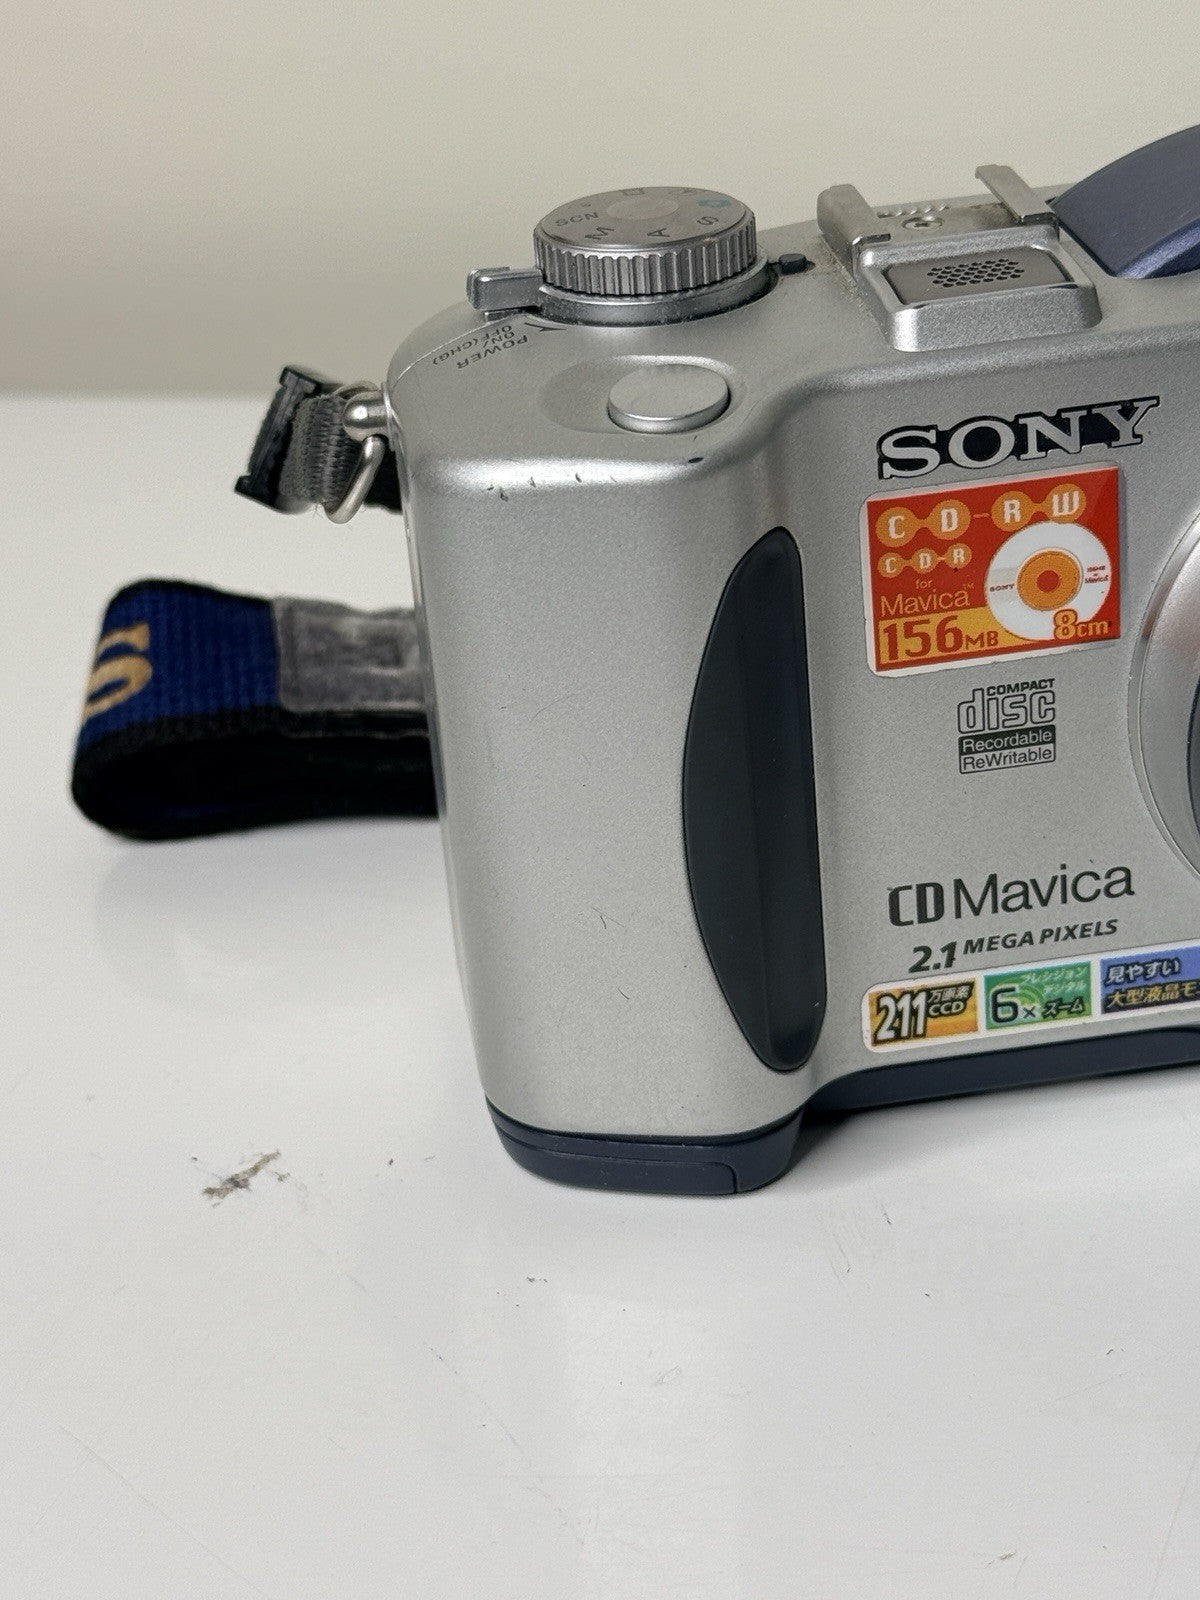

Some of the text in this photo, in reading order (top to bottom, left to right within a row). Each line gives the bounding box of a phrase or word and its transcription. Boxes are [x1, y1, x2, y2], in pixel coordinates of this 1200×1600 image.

[555, 211, 599, 227] SCN
[647, 227, 671, 239] A
[457, 335, 528, 369] POWER
[876, 396, 1160, 480] SONY
[915, 578, 933, 590] for
[989, 583, 1015, 593] SONY
[1053, 609, 1109, 640] 8cm
[987, 678, 1055, 696] COMPACT
[957, 688, 1055, 734] disc
[962, 730, 1053, 753] Recordable
[963, 747, 1052, 770] ReWritable
[953, 863, 1135, 919] Mavica
[908, 918, 1118, 973] 2.1 MEGA PIXELS
[1105, 959, 1180, 985] 見やすい
[1041, 997, 1084, 1017] ズーム
[1106, 981, 1200, 1009] 大型液晶モ
[874, 989, 930, 1043] 211
[928, 1000, 965, 1016] CCD
